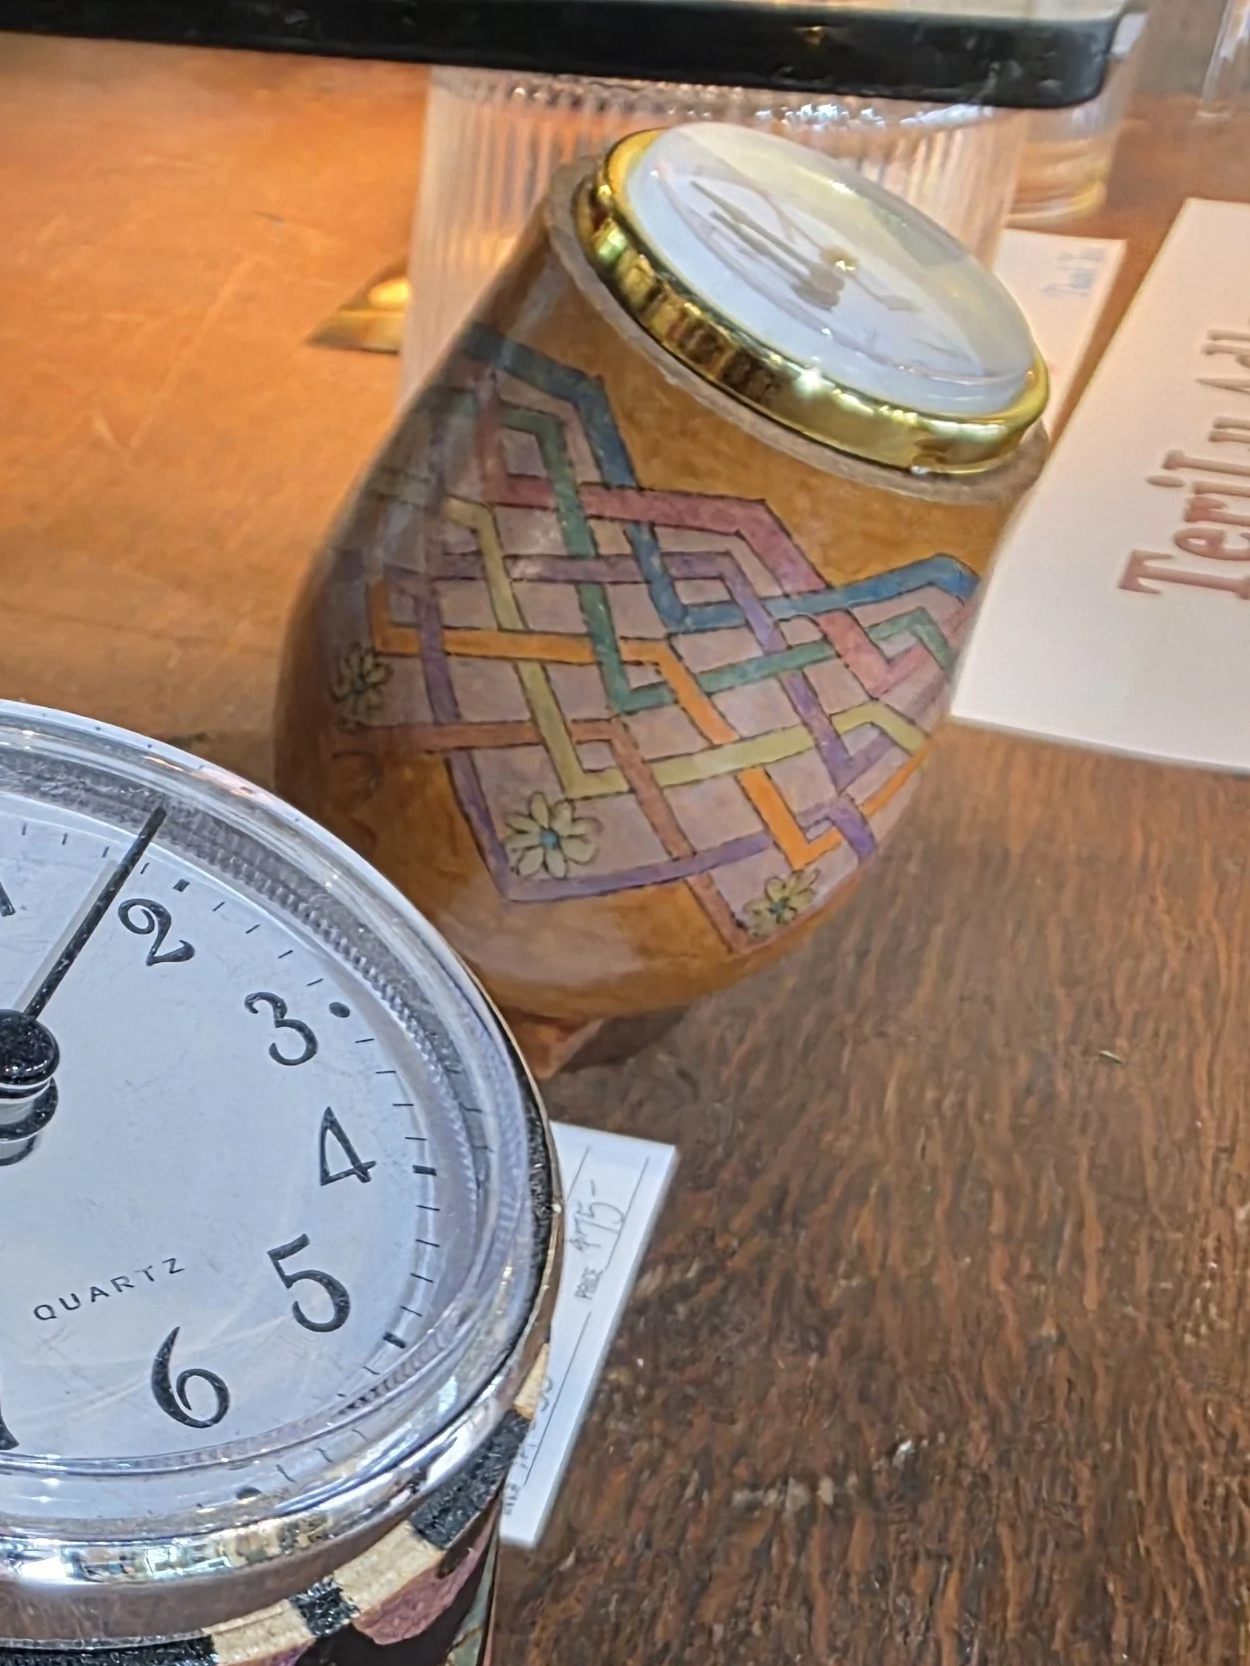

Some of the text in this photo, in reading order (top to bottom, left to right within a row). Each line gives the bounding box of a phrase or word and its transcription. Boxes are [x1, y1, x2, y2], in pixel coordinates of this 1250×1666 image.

[119, 897, 196, 967] 2
[244, 991, 318, 1067] 3
[319, 1106, 377, 1187] 4
[33, 1257, 185, 1321] QUARTZ
[266, 1233, 351, 1333] 5
[150, 1326, 231, 1430] 6
